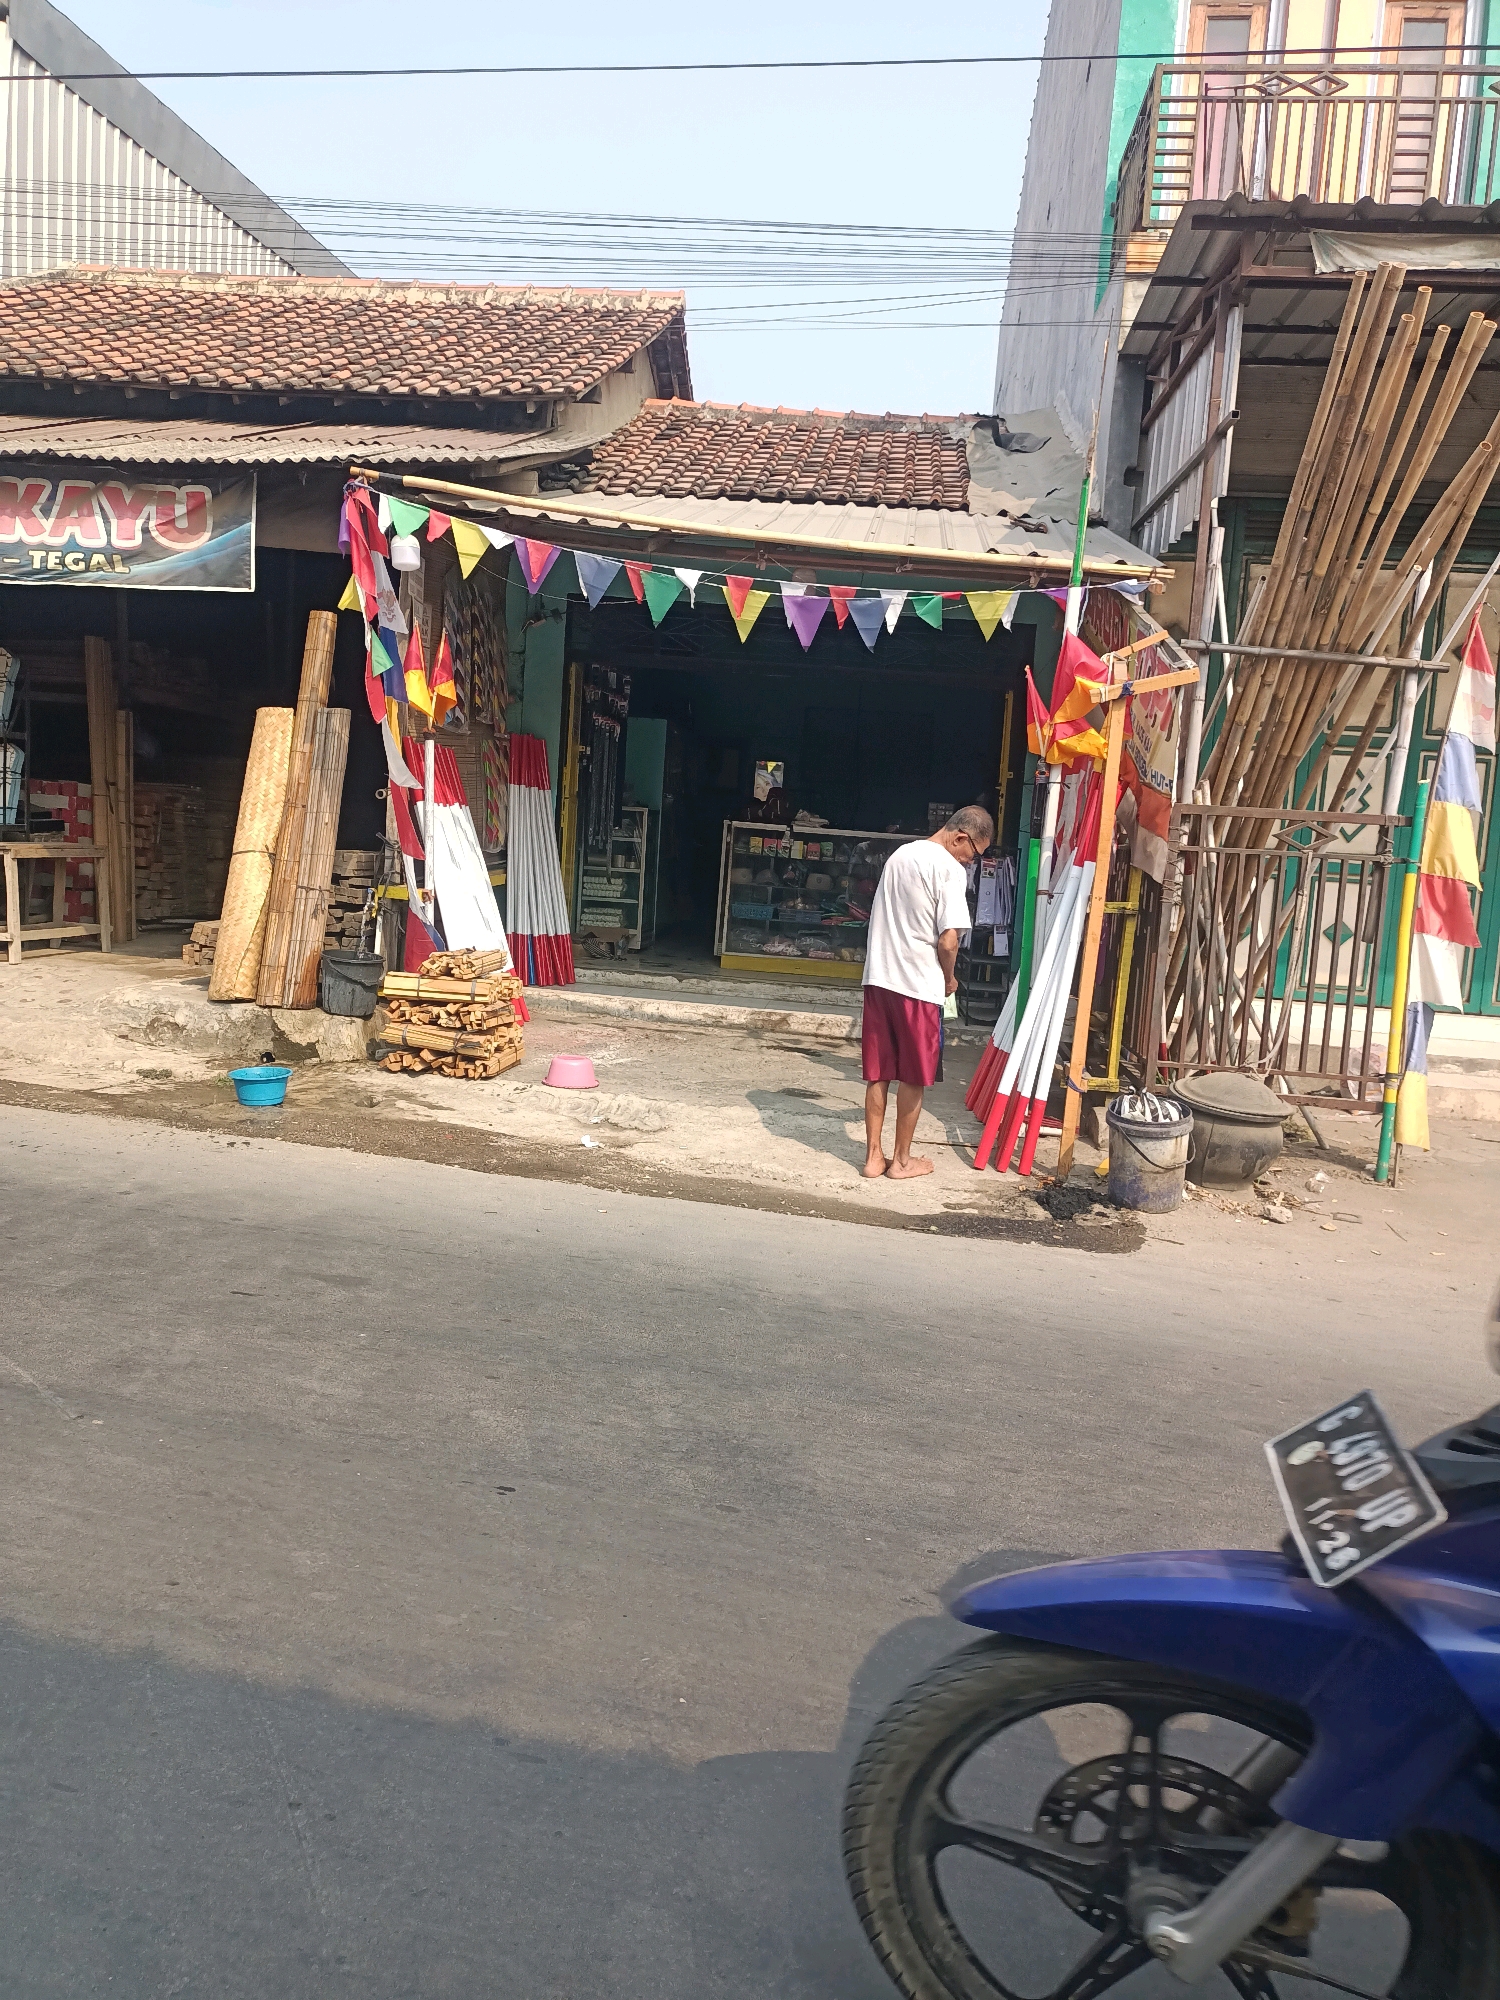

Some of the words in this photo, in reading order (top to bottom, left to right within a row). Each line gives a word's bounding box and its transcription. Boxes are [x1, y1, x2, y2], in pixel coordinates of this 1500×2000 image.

[0, 476, 212, 549] KAYU
[28, 550, 130, 573] TEGAL
[1354, 1487, 1421, 1533] UP
